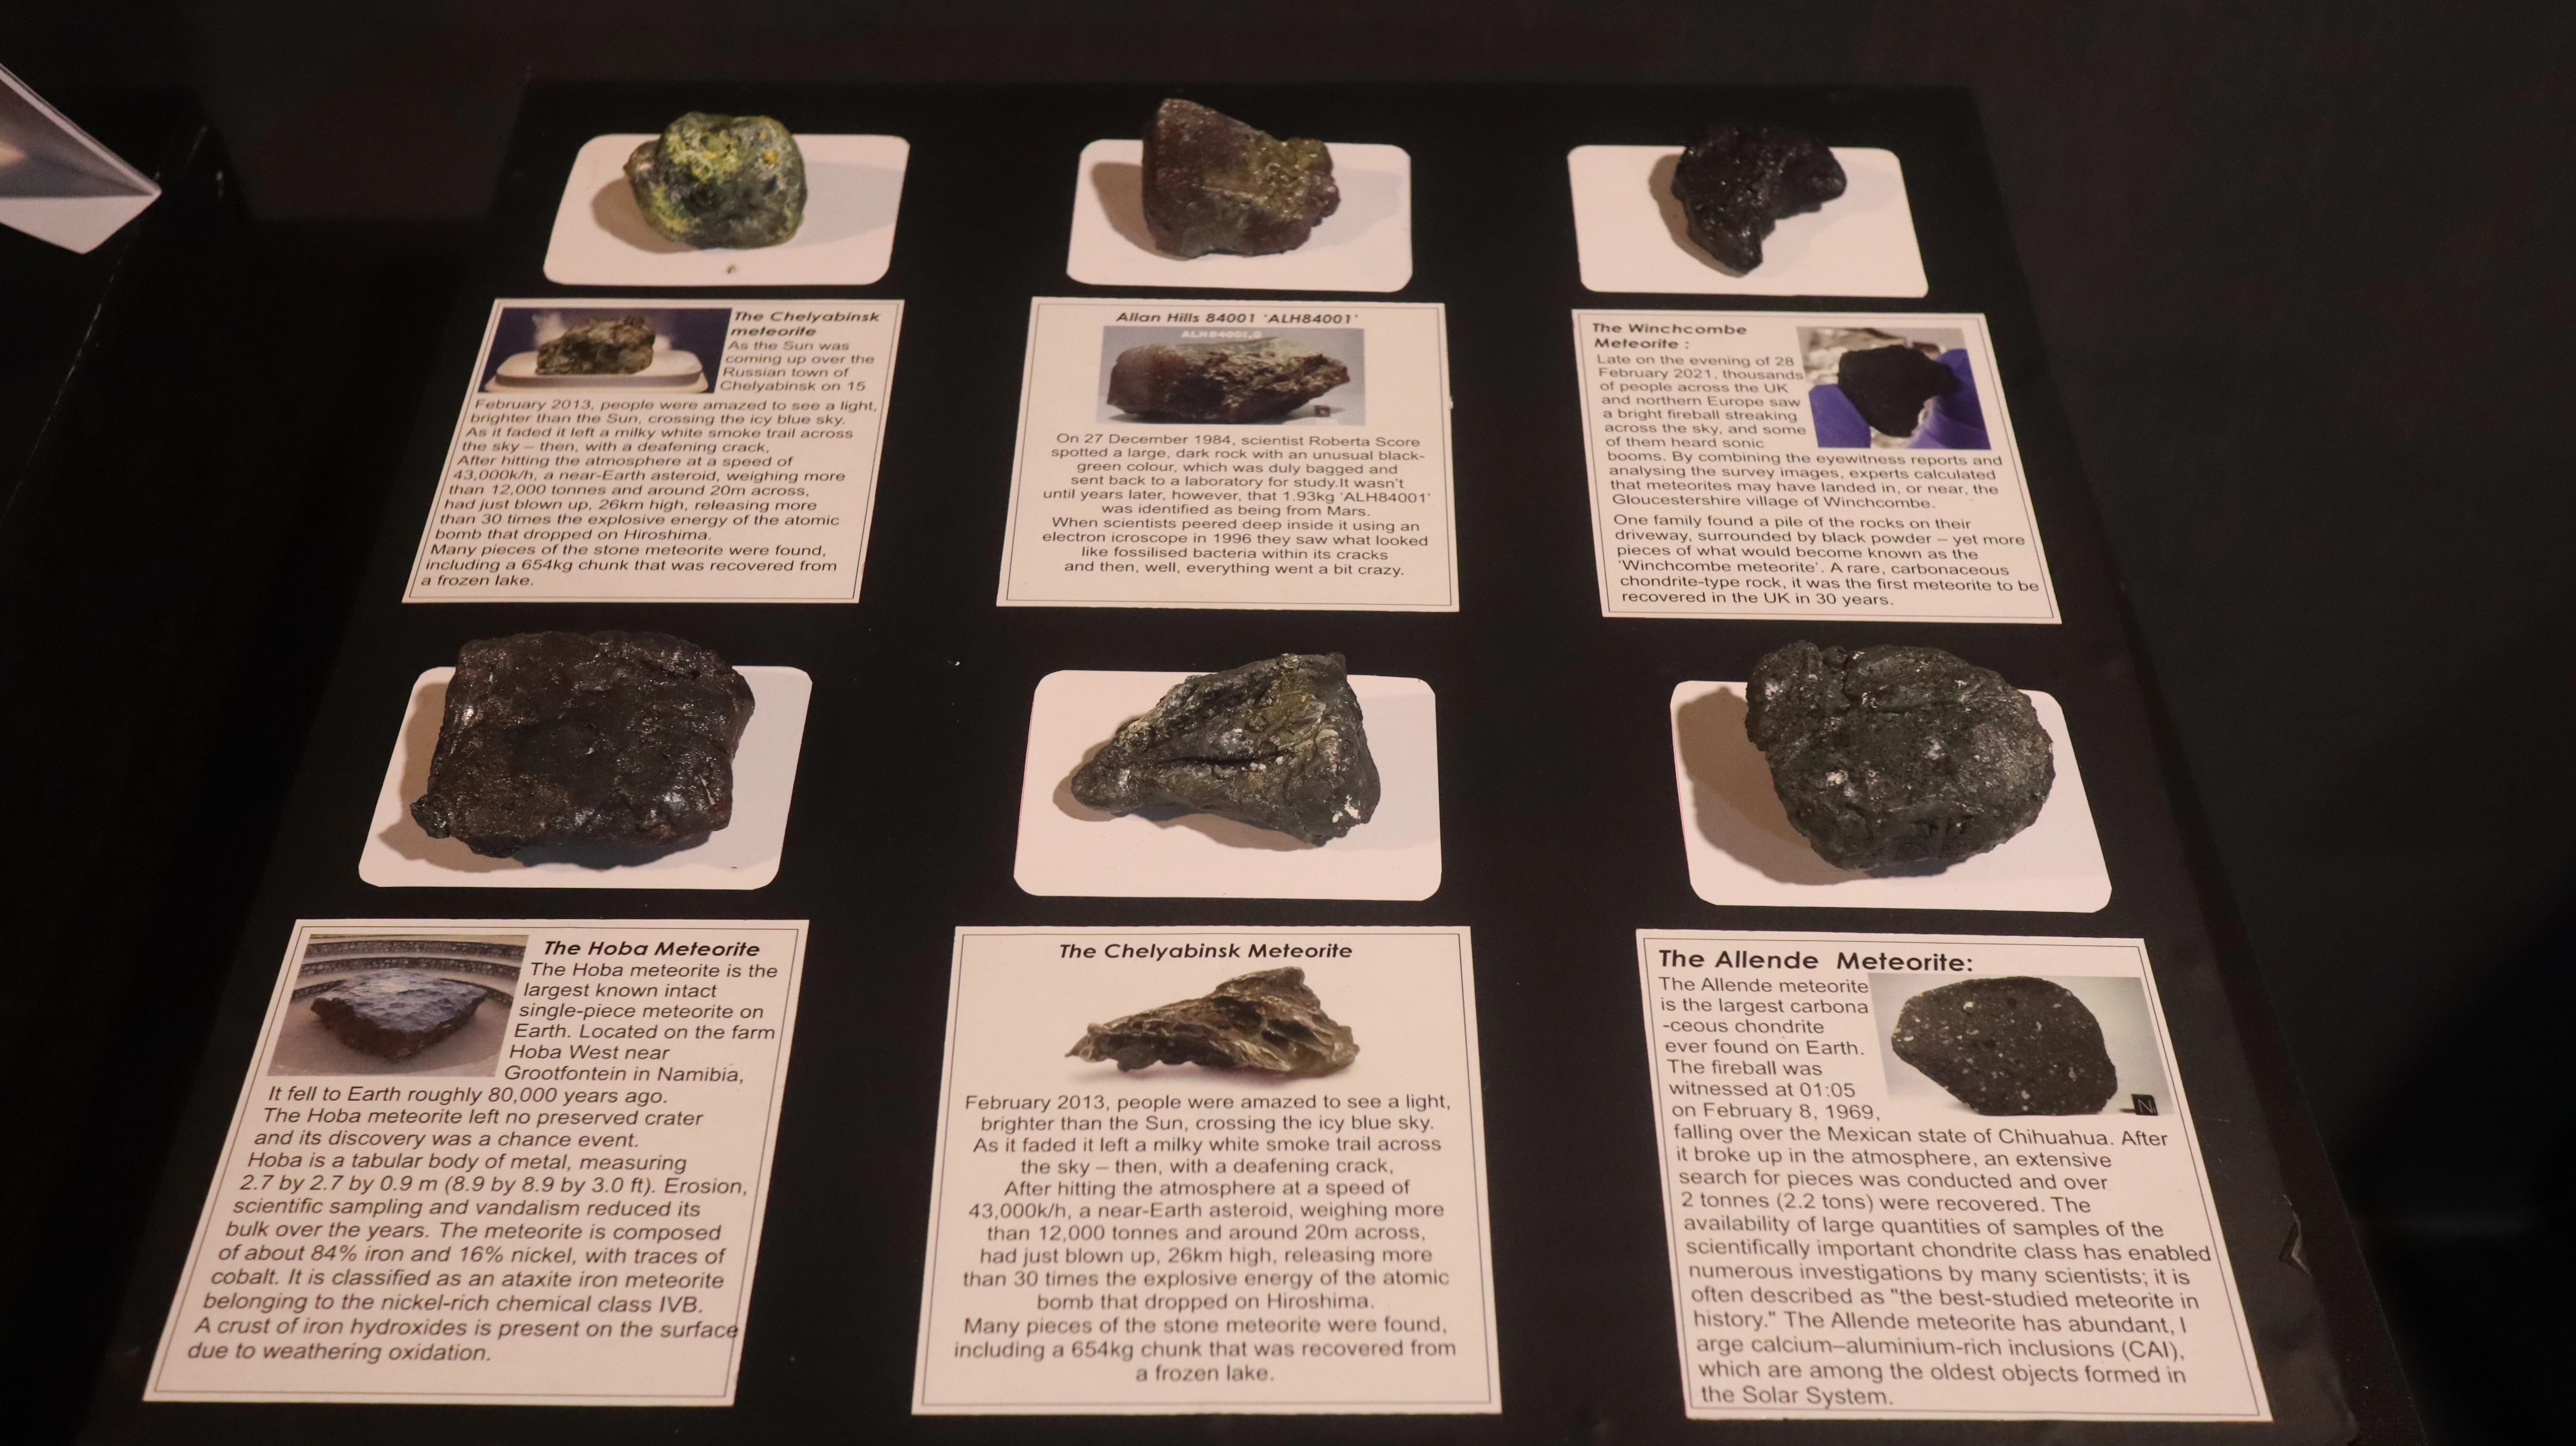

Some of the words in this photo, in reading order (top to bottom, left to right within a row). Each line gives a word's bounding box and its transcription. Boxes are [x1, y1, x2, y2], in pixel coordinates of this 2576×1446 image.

[735, 311, 764, 322] The
[770, 311, 880, 324] Chelyabinsk
[1116, 312, 1161, 322] Allan
[1167, 313, 1199, 322] Hills
[1206, 313, 1255, 323] 84001
[731, 326, 817, 337] meteorite
[1592, 323, 1622, 333] The
[1628, 324, 1747, 334] Winchcombe
[729, 341, 748, 350] As
[754, 341, 778, 350] the
[784, 341, 813, 350] Sun
[1594, 338, 1679, 349] Meteorite
[726, 355, 782, 365] coming
[787, 356, 806, 365] up
[851, 355, 875, 364] the
[1597, 355, 1630, 364] Late
[1660, 355, 1684, 365] the
[1689, 358, 1750, 368] evening
[1756, 356, 1769, 366] of
[1775, 357, 1794, 366] 28
[723, 367, 786, 377] Russian
[792, 368, 828, 377] town
[833, 368, 849, 377] of
[1599, 368, 1668, 380] February
[1674, 369, 1717, 379] 2021,
[1722, 370, 1804, 380] thousands
[720, 381, 815, 393] Chelyabinsk
[848, 381, 865, 391] 15
[1057, 433, 1079, 443] On
[1084, 434, 1103, 443] 27
[1109, 434, 1188, 444] December
[1195, 435, 1235, 446] 1984,
[1242, 436, 1303, 446] scientist
[1309, 436, 1370, 447] Roberta
[1376, 437, 1420, 447] Score
[453, 470, 537, 481] 43,000k/h,
[559, 470, 645, 480] near-Earth
[651, 471, 719, 482] asteroid,
[727, 471, 798, 483] weighing
[804, 473, 845, 481] more
[1043, 489, 1075, 498] until
[1081, 491, 1123, 501] years
[1129, 489, 1165, 501] later,
[1172, 490, 1241, 501] however,
[1248, 491, 1276, 501] that
[1284, 491, 1334, 504] 1.93kg
[1613, 494, 1741, 505] Gloucestershire
[1746, 495, 1798, 509] village
[1804, 496, 1818, 507] of
[1823, 496, 1935, 508] Winchcombe.
[1622, 592, 1706, 602] recovered
[1712, 592, 1726, 603] in
[1732, 592, 1758, 603] the
[1764, 592, 1790, 604] UK
[1795, 593, 1810, 604] in
[1816, 593, 1836, 604] 30
[1842, 596, 1893, 607] years.
[544, 940, 581, 955] The
[587, 941, 649, 956] Hoba
[654, 942, 760, 957] Meteorite
[1060, 944, 1097, 959] The
[1104, 943, 1241, 962] Chelyabinsk
[1248, 943, 1352, 958] Meteorite
[1659, 949, 1705, 968] The
[1714, 950, 1819, 969] Allende
[1837, 952, 1972, 972] Meteorite:
[531, 962, 566, 976] The
[572, 963, 623, 977] Hoba
[630, 963, 720, 977] meteorite
[726, 964, 741, 978] is
[749, 964, 778, 978] the
[524, 982, 590, 1000] largest
[595, 983, 658, 997] known
[665, 984, 717, 998] intact
[1658, 977, 1695, 991] The
[1701, 978, 1772, 992] Allende
[1779, 979, 1868, 993] meteorite
[519, 1003, 636, 1021] single-piece
[642, 1004, 733, 1018] meteorite
[740, 1008, 763, 1019] on
[1661, 997, 1676, 1011] is
[1682, 998, 1712, 1012] the
[1719, 998, 1784, 1016] largest
[1790, 999, 1868, 1014] carbona
[1663, 1021, 1728, 1033] -ceous
[1735, 1020, 1824, 1034] chondrite
[509, 1044, 562, 1059] Hoba
[570, 1045, 619, 1060] West
[625, 1048, 670, 1060] near
[1665, 1042, 1707, 1053] ever
[1713, 1039, 1768, 1054] found
[1776, 1043, 1799, 1054] on
[1806, 1040, 1864, 1055] Earth.
[504, 1065, 626, 1081] Grootfontein
[633, 1066, 650, 1081] in
[657, 1064, 743, 1084] Namibia,
[1669, 1081, 1768, 1097] witnessed
[1776, 1083, 1794, 1097] at
[1800, 1082, 1855, 1098] 01:05
[966, 1095, 1051, 1113] February
[1057, 1095, 1109, 1111] 2013,
[1118, 1094, 1181, 1113] people
[1188, 1098, 1234, 1109] were
[1241, 1094, 1316, 1109] amazed
[1323, 1095, 1341, 1109] to
[1348, 1097, 1381, 1109] see
[1388, 1097, 1399, 1108] a
[1406, 1094, 1450, 1112] light,
[1672, 1106, 1696, 1117] on
[1703, 1102, 1792, 1122] February
[1799, 1104, 1817, 1121] 8,
[1826, 1104, 1880, 1121] 1969,
[987, 1225, 1030, 1241] than
[1040, 1225, 1105, 1242] 12,000
[1112, 1226, 1178, 1240] tonnes
[1185, 1224, 1221, 1240] and
[1229, 1224, 1297, 1240] around
[1305, 1224, 1347, 1240] 20m
[1355, 1227, 1425, 1241] across,
[203, 1292, 308, 1314] belonging
[315, 1294, 334, 1310] to
[341, 1293, 374, 1310] the
[381, 1294, 489, 1311] nickel-rich
[496, 1295, 592, 1312] chemical
[598, 1295, 652, 1313] class
[659, 1296, 702, 1313] IVB.
[954, 1341, 1045, 1362] including
[1052, 1345, 1064, 1358] a
[1072, 1341, 1133, 1362] 654kg
[1141, 1340, 1202, 1358] chunk
[1209, 1341, 1247, 1357] that
[1254, 1344, 1294, 1357] was
[1302, 1340, 1403, 1357] recovered
[1411, 1339, 1456, 1356] from
[1697, 1339, 1744, 1356] arge
[2008, 1339, 2114, 1358] inclusions
[2122, 1340, 2184, 1362] (CAI),
